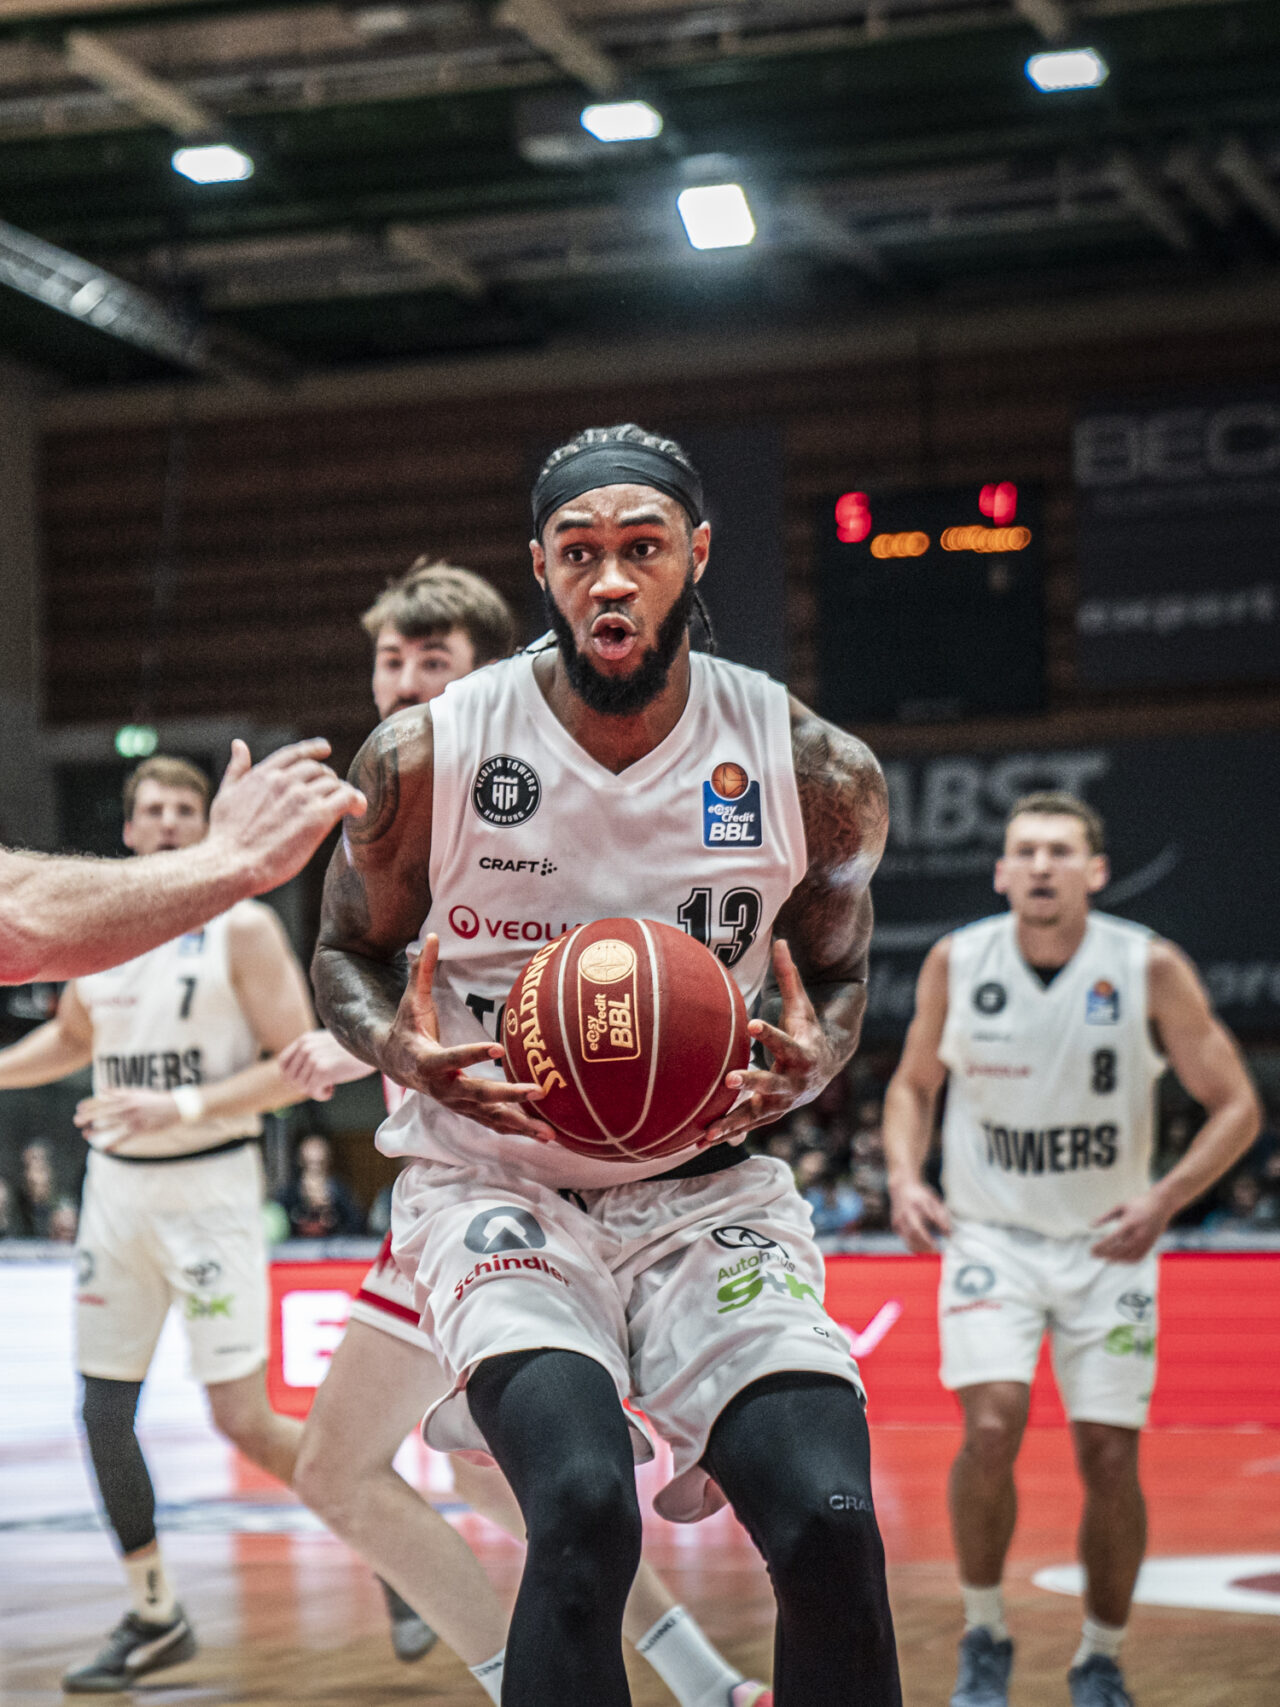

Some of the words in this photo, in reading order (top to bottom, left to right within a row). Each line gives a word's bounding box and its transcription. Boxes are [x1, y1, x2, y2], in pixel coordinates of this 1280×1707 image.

[476, 758, 503, 789] VEOLIA
[506, 760, 537, 793] TOWERS
[483, 808, 525, 823] HAMBURG
[709, 822, 755, 841] BBL
[721, 812, 755, 823] Credit
[479, 856, 540, 873] CRAFT
[677, 886, 763, 970] 13
[179, 975, 198, 1020] 7
[520, 937, 568, 1097] SPALDING
[594, 993, 608, 1034] Credit
[607, 993, 634, 1049] BBL
[1090, 1047, 1117, 1096] 8
